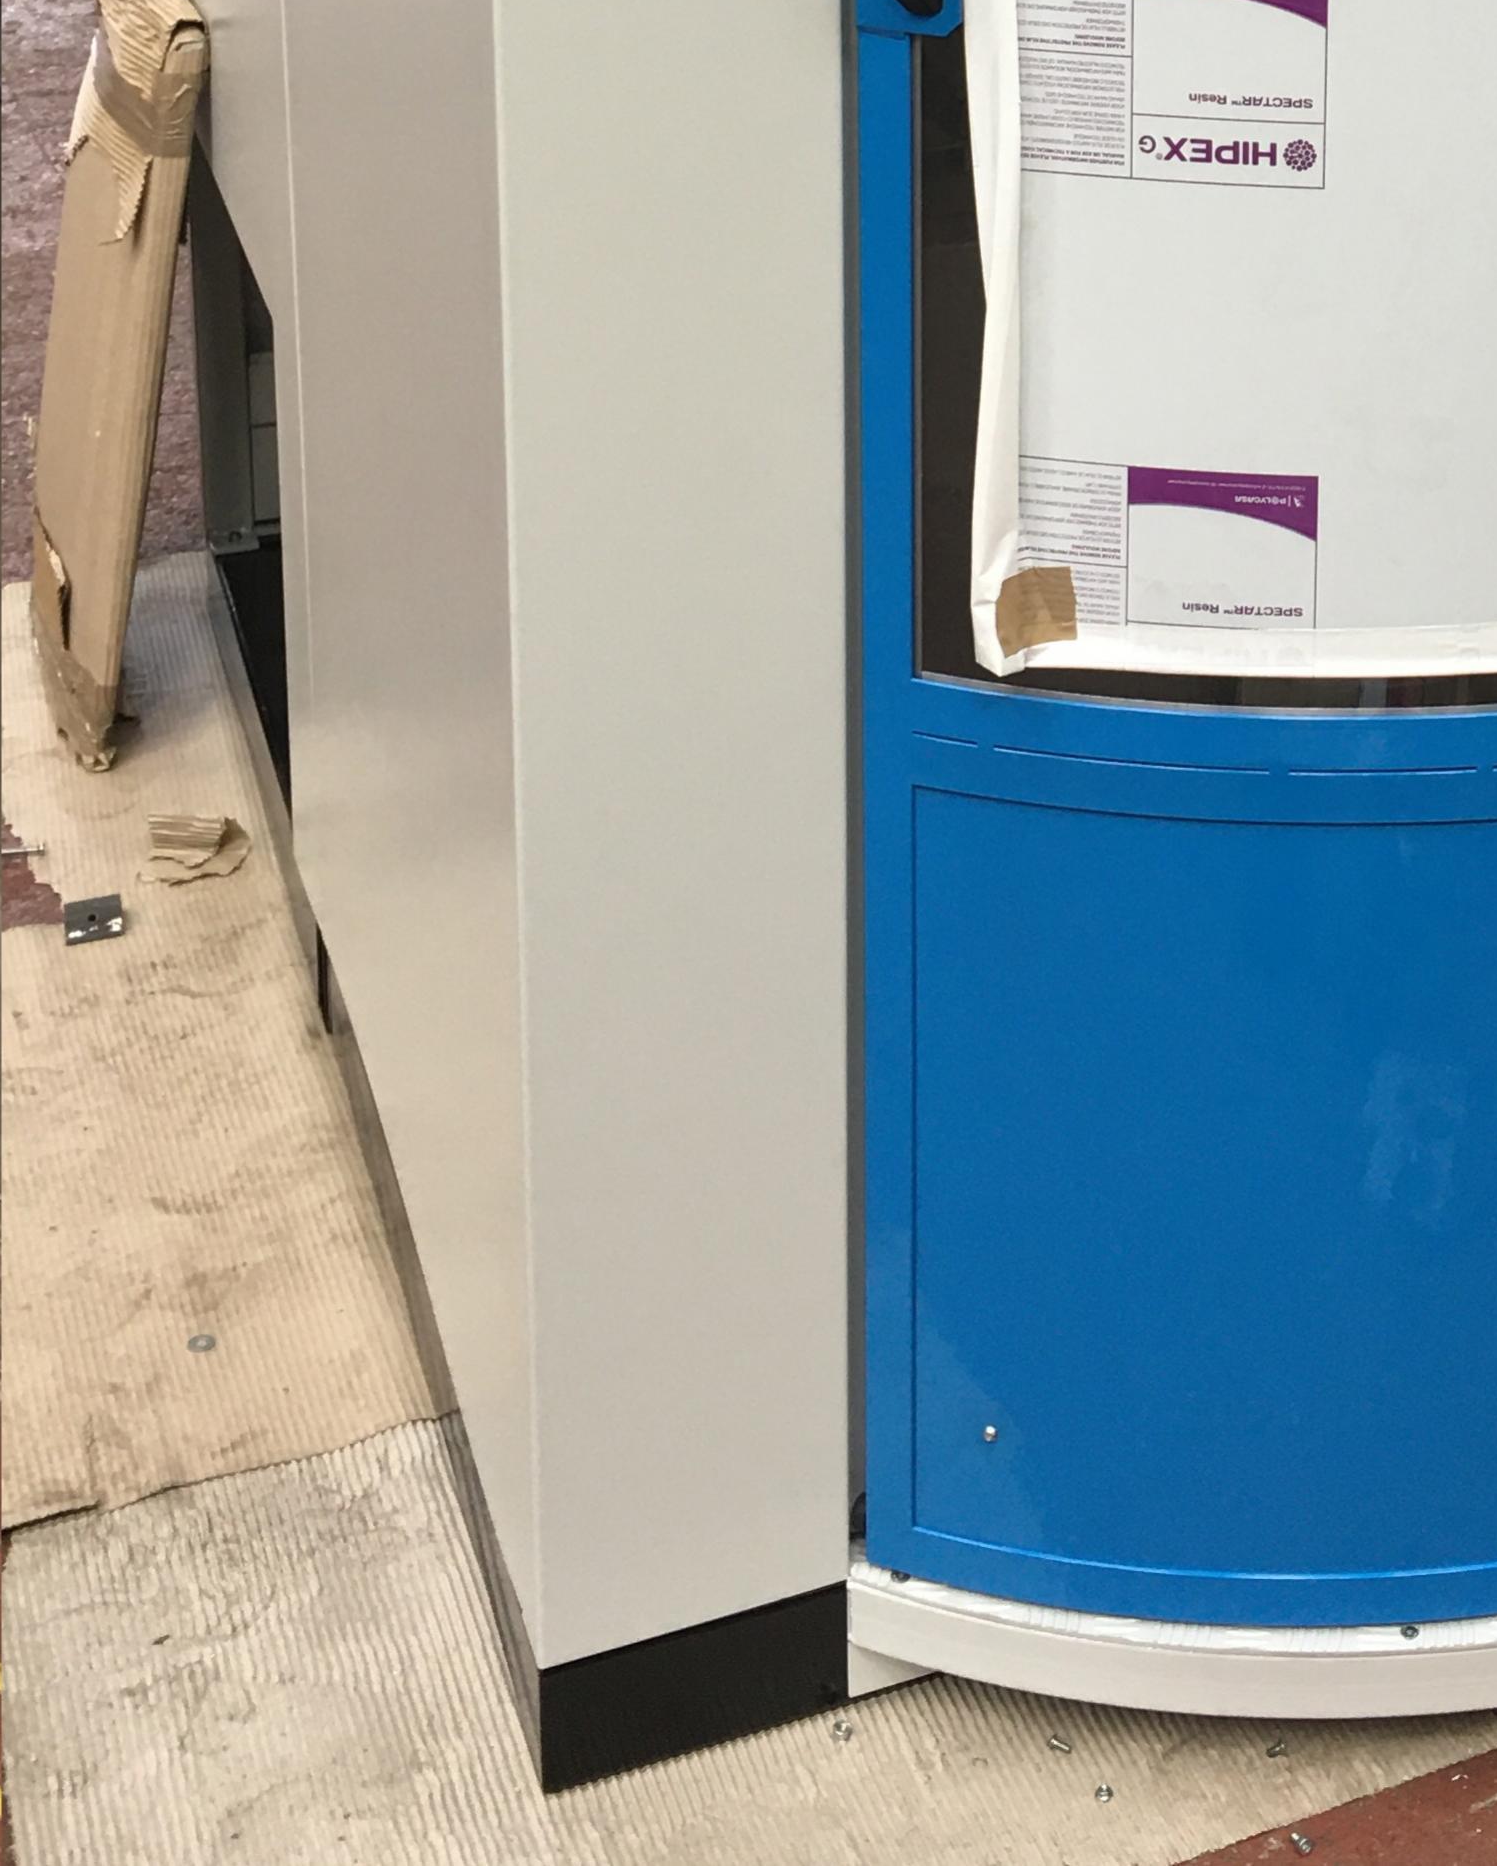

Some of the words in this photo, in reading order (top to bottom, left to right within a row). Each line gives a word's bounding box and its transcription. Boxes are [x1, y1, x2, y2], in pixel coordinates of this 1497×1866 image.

[1189, 93, 1227, 105] Resin
[1138, 135, 1156, 154] G
[1182, 602, 1219, 614] Resin
